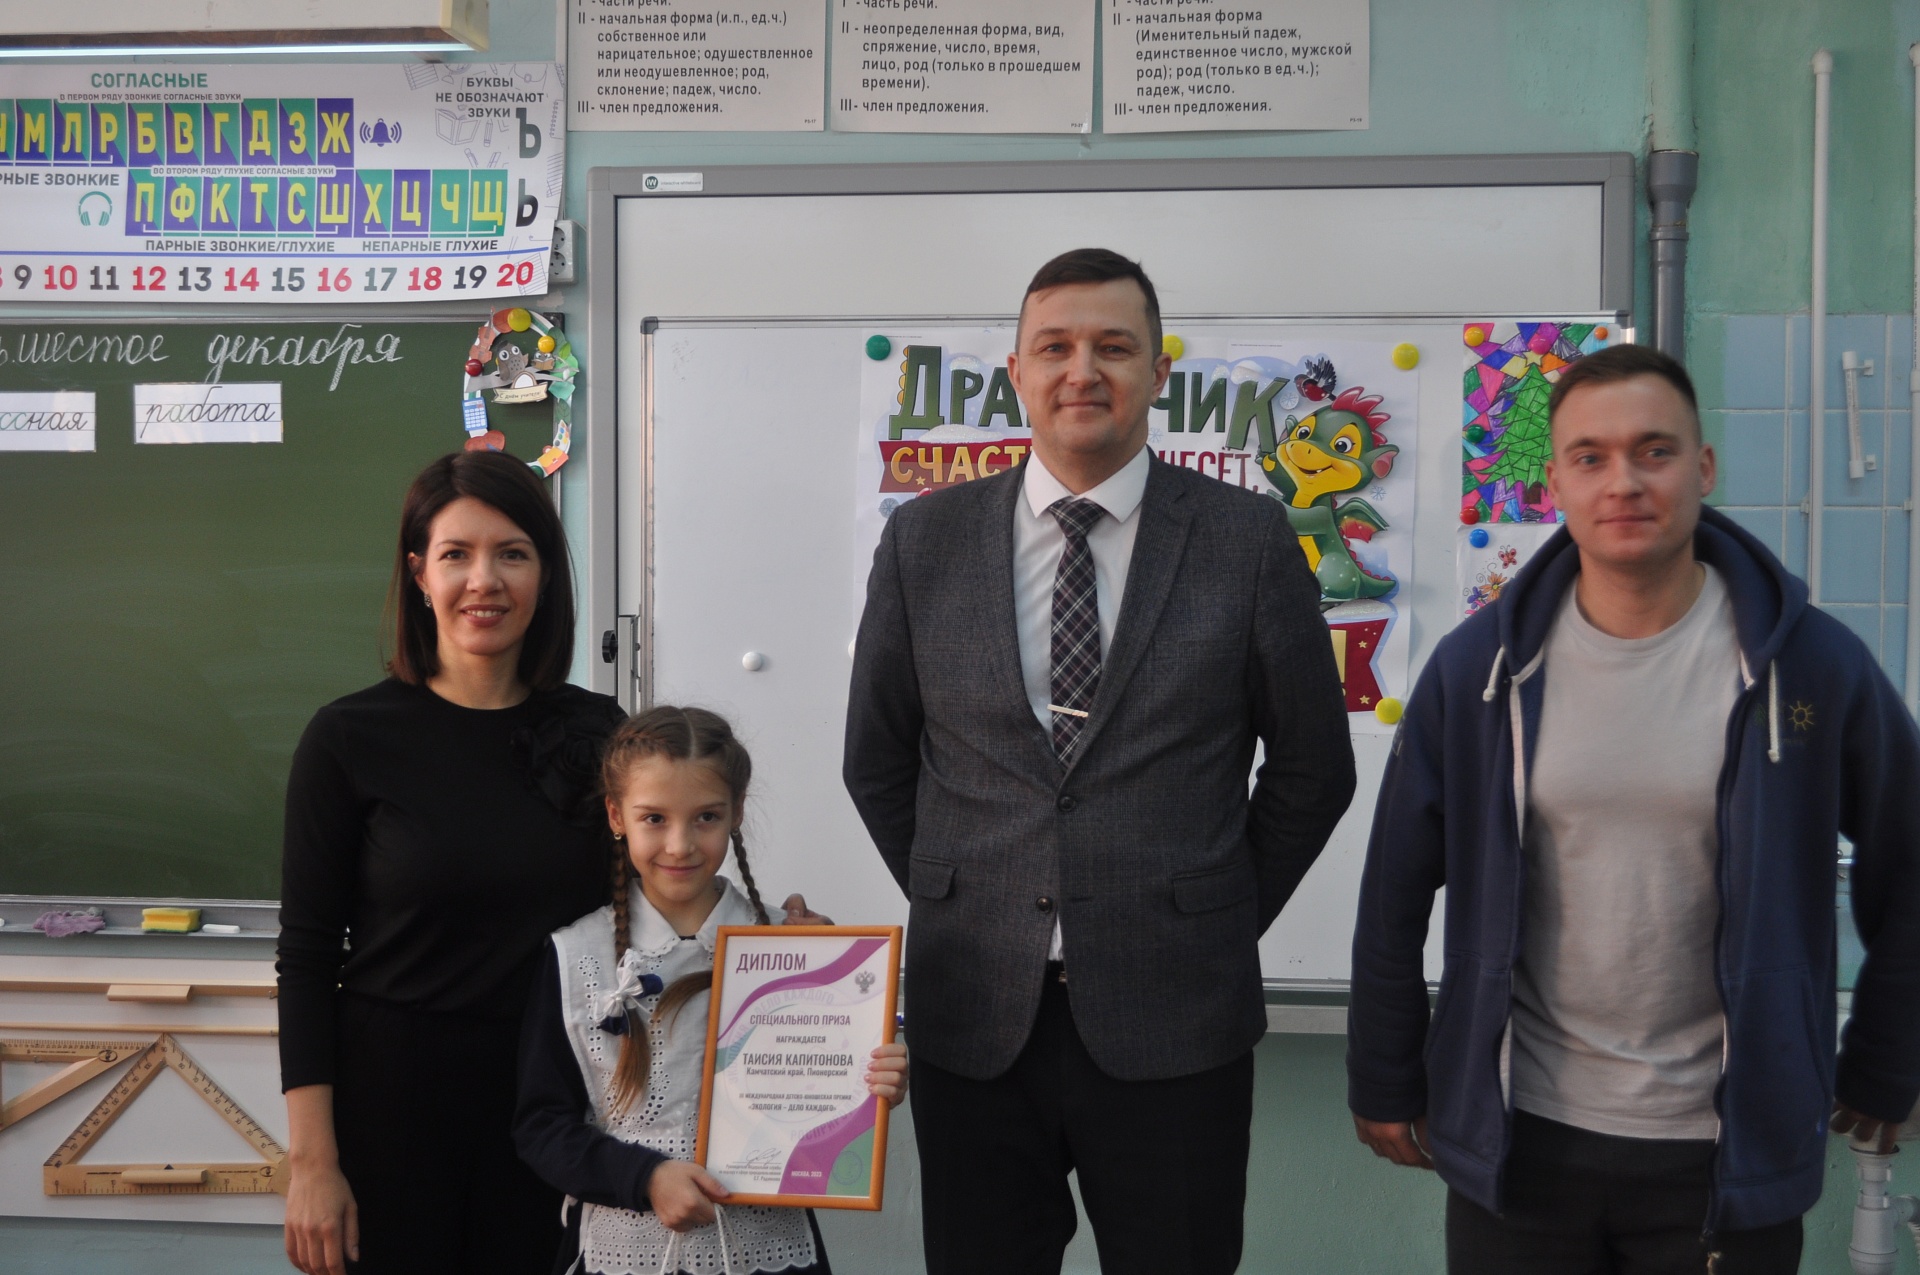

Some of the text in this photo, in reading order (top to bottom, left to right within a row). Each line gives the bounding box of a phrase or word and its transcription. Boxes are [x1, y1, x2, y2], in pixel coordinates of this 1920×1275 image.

[863, 0, 938, 11] часть речи.
[599, 13, 667, 25] начальная
[670, 11, 713, 27] форма
[716, 11, 748, 27] (и.п.,
[751, 10, 787, 27] ед.ч.)
[1135, 12, 1211, 25] начальная
[1215, 9, 1263, 25] форма
[597, 30, 707, 42] собственное или
[863, 24, 978, 38] неопределенная
[981, 22, 1032, 38] форма,
[1035, 25, 1064, 38] вид,
[1135, 26, 1302, 46] (Именительный падеж,
[597, 48, 814, 63] нарицательное; одушествленное
[862, 42, 1040, 56] спряжение, число, время,
[1135, 42, 1352, 62] единственное число, мужской
[597, 66, 769, 80] или неодушевленное; род,
[862, 58, 1081, 75] лицо, род (только в прошедшем
[1136, 61, 1319, 82] род); род (только в ед.ч.);
[91, 73, 209, 89] СОГЛАСНЫЕ
[466, 77, 514, 88] БУКВЫ
[862, 75, 930, 92] времени).
[59, 93, 242, 102] В ПЕРВОМ РЯДУ ЗВОНКИЕ СОГЛАСНЫЕ ЗВУКИ
[435, 92, 545, 103] НЕ ОБОЗНАЧАЮТ
[597, 84, 762, 98] склонение; падеж, число.
[1136, 83, 1235, 98] падеж, число.
[468, 107, 511, 118] ЗВУКИ
[599, 103, 630, 113] член
[632, 102, 723, 116] предложения.
[862, 101, 893, 112] член
[896, 102, 989, 115] предложения.
[1137, 104, 1170, 115] член
[1174, 101, 1272, 116] предложения.
[515, 107, 542, 159] Ъ
[153, 167, 334, 176] ВО ВТОРОМ РЯДУ ГЛУХИЕ СОГЛАСНЫЕ ЗВУКИ
[44, 173, 120, 186] ЗВОНКИЕ
[515, 178, 539, 227] Ь
[146, 240, 335, 253] ПАРНЫЕ ЗВОНКИЕ/ГЛУХИЕ
[362, 239, 499, 252] НЕПАРНЫЕ ГЛУХИЕ
[14, 264, 32, 290] 9
[44, 264, 78, 291] 10
[90, 265, 120, 291] 11
[132, 265, 167, 291] 12
[178, 266, 212, 292] 13
[224, 267, 260, 292] 14
[271, 267, 305, 292] 15
[317, 267, 353, 292] 16
[364, 267, 398, 292] 17
[407, 266, 443, 291] 18
[453, 265, 488, 290] 19
[496, 261, 534, 288] 20
[204, 323, 404, 392] декабря
[139, 385, 276, 439] работа
[735, 953, 807, 974] ДИПЛОМ
[749, 1014, 851, 1026] СПЕЦИАЛЬНОГО ПРИЗА
[775, 1035, 827, 1044] НАГРАЖДАЕТСЯ
[742, 1053, 854, 1067] ТАИСИЯ КАПИТОНОВА
[746, 1067, 848, 1077] Камчатский край, Пионерский
[788, 1103, 805, 1112] ДЕЛО
